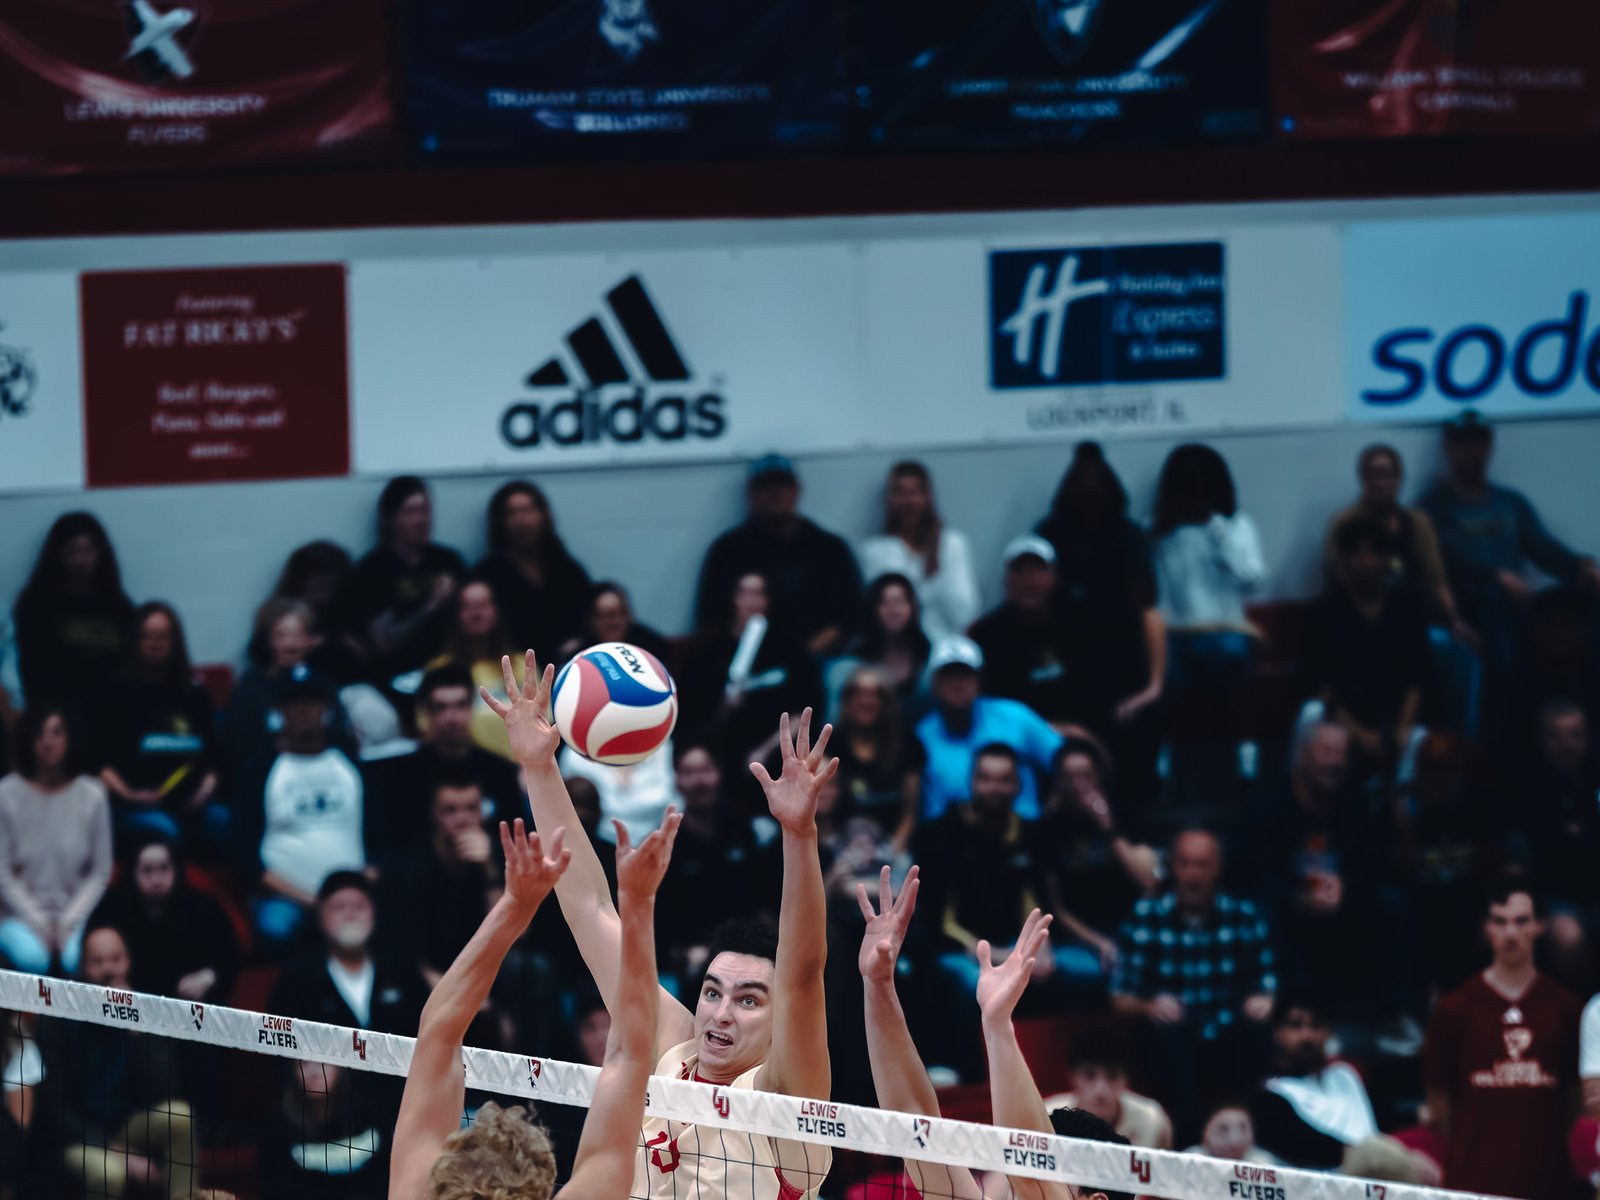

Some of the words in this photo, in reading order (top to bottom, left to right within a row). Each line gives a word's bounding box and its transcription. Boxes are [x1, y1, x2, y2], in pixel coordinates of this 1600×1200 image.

[1360, 288, 1600, 407] sod
[500, 386, 727, 448] adidas
[102, 1003, 140, 1023] FLYERS
[262, 1015, 293, 1032] LEWIS
[258, 1029, 298, 1050] FLYERS
[801, 1100, 839, 1120] LEWIS
[796, 1116, 847, 1139] FLYERS
[1008, 1131, 1050, 1152] LEWIS
[1003, 1147, 1057, 1172] FLYERS
[1233, 1164, 1278, 1185] LEWIS
